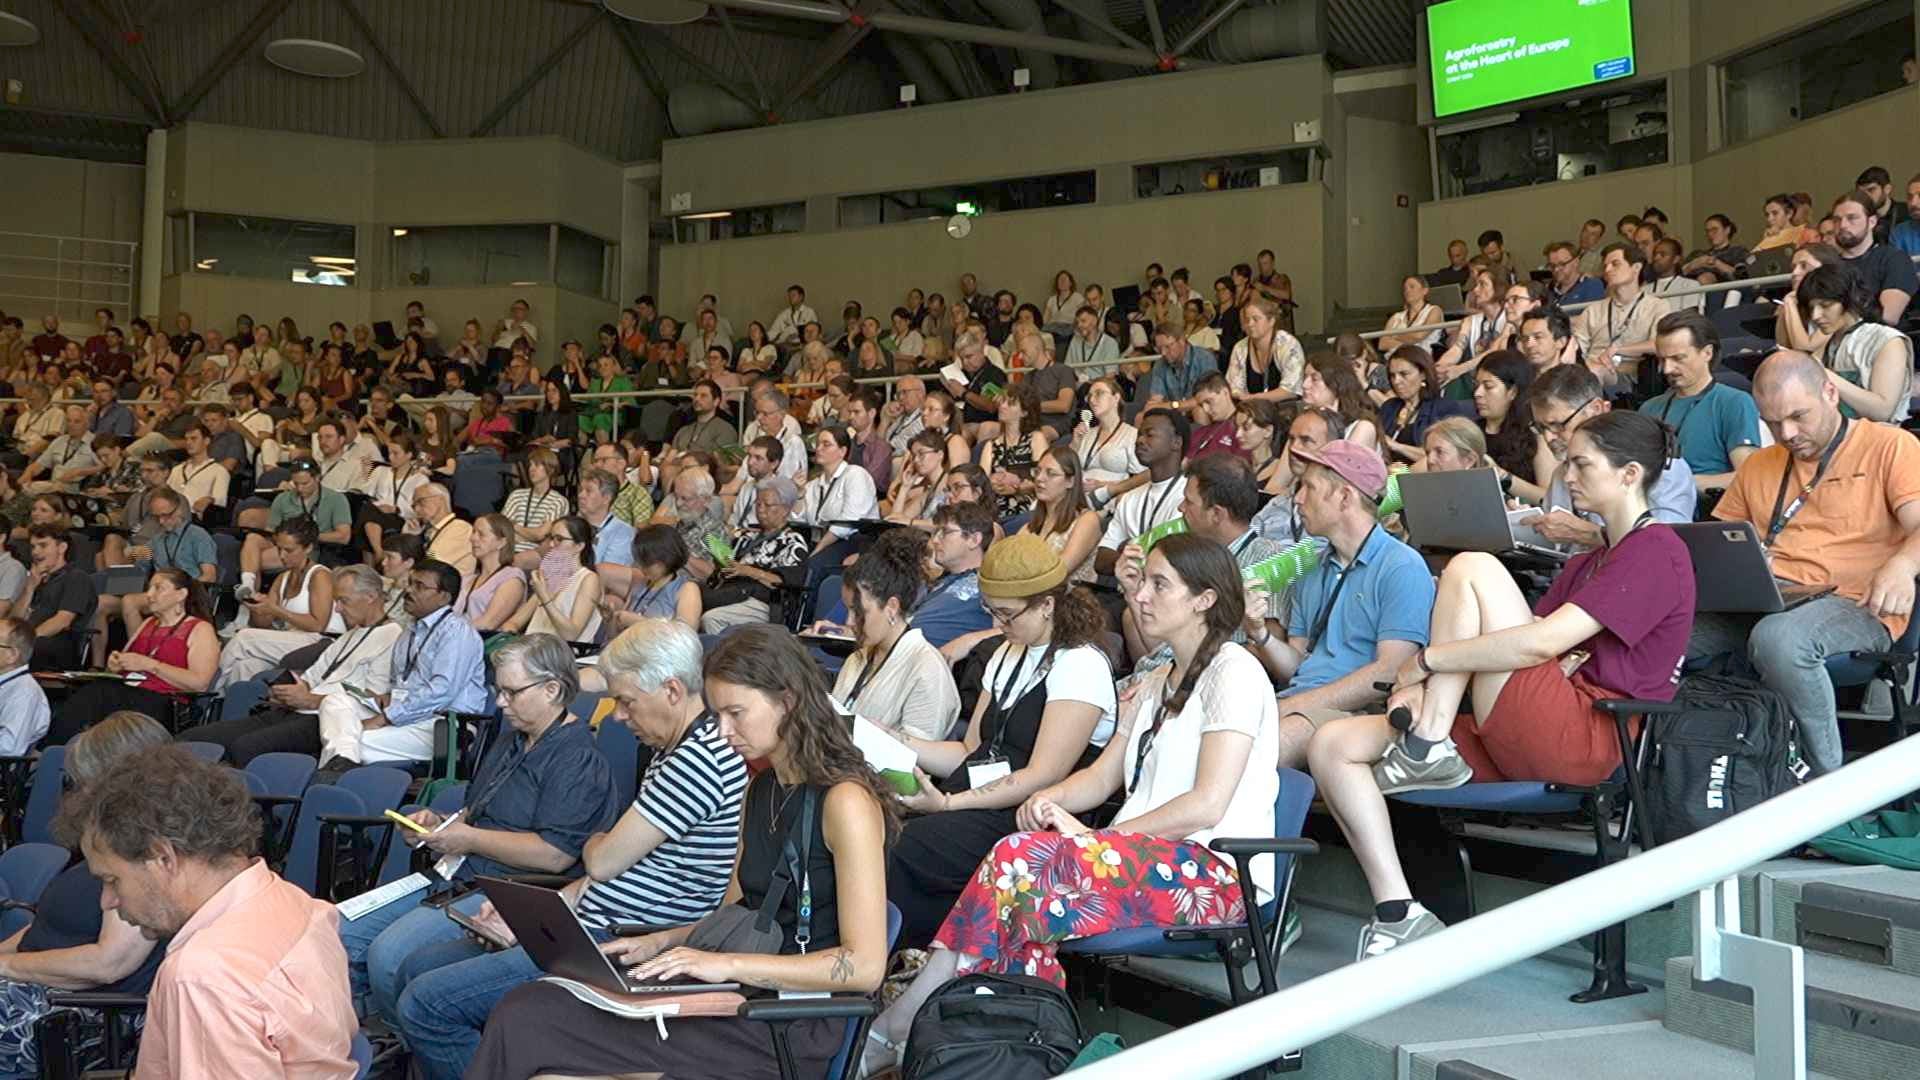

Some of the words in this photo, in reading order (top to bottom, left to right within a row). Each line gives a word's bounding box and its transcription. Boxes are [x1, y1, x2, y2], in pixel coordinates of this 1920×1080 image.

[1445, 36, 1516, 61] Agroforestry
[1445, 64, 1458, 74] at
[1459, 60, 1478, 71] the
[1479, 51, 1512, 67] Heart
[1513, 45, 1527, 59] of
[1528, 38, 1570, 56] Europe
